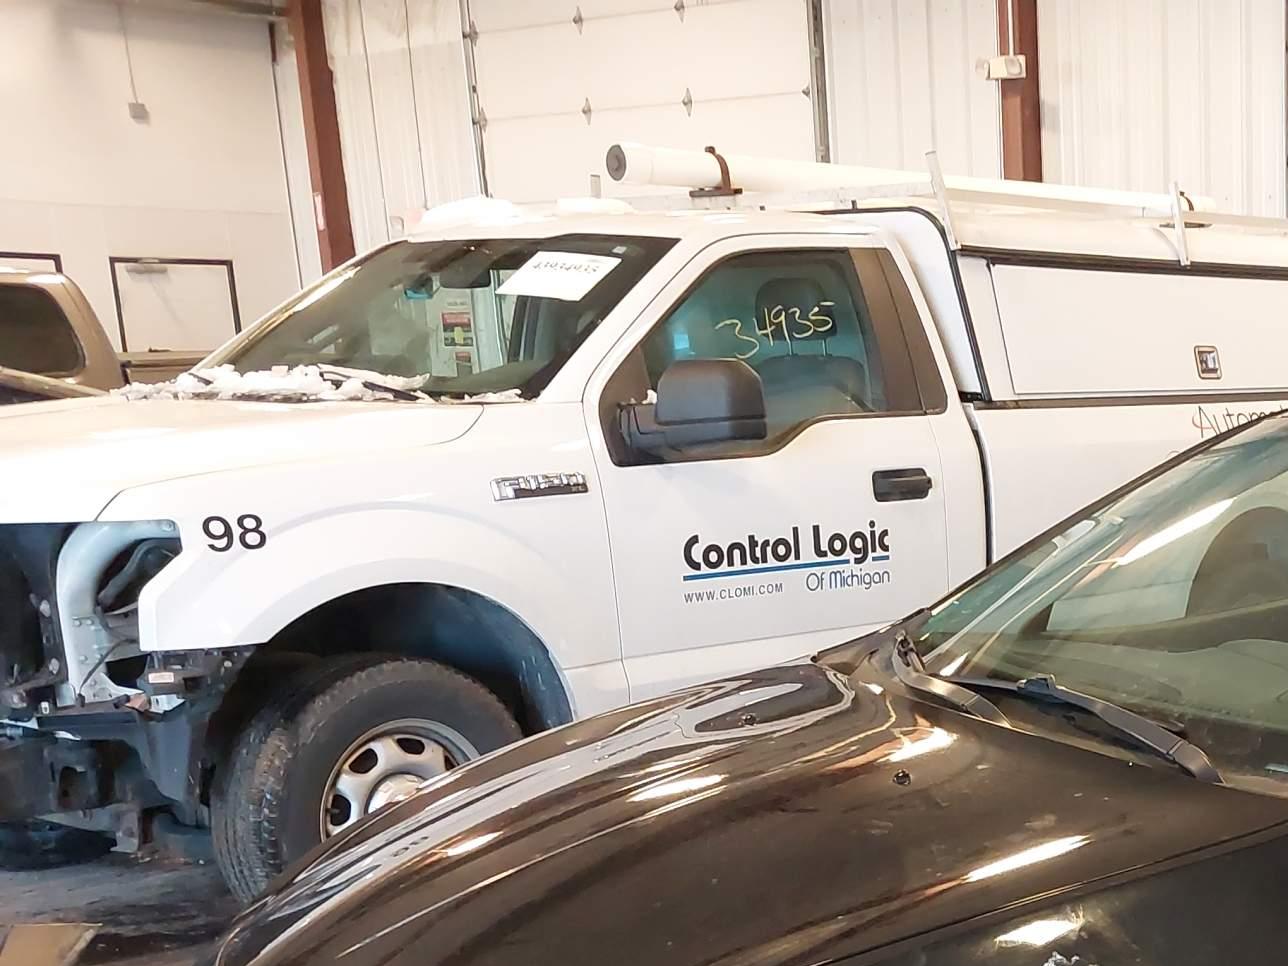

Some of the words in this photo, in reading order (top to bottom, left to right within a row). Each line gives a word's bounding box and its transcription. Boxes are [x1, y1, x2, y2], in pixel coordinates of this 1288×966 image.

[714, 301, 836, 359] 34935
[202, 514, 267, 552] 98
[684, 526, 801, 571] Control
[812, 520, 890, 564] Logic
[683, 583, 784, 603] WWW.CLOMI.COM
[806, 571, 826, 592] Of
[829, 568, 891, 590] Michigan
